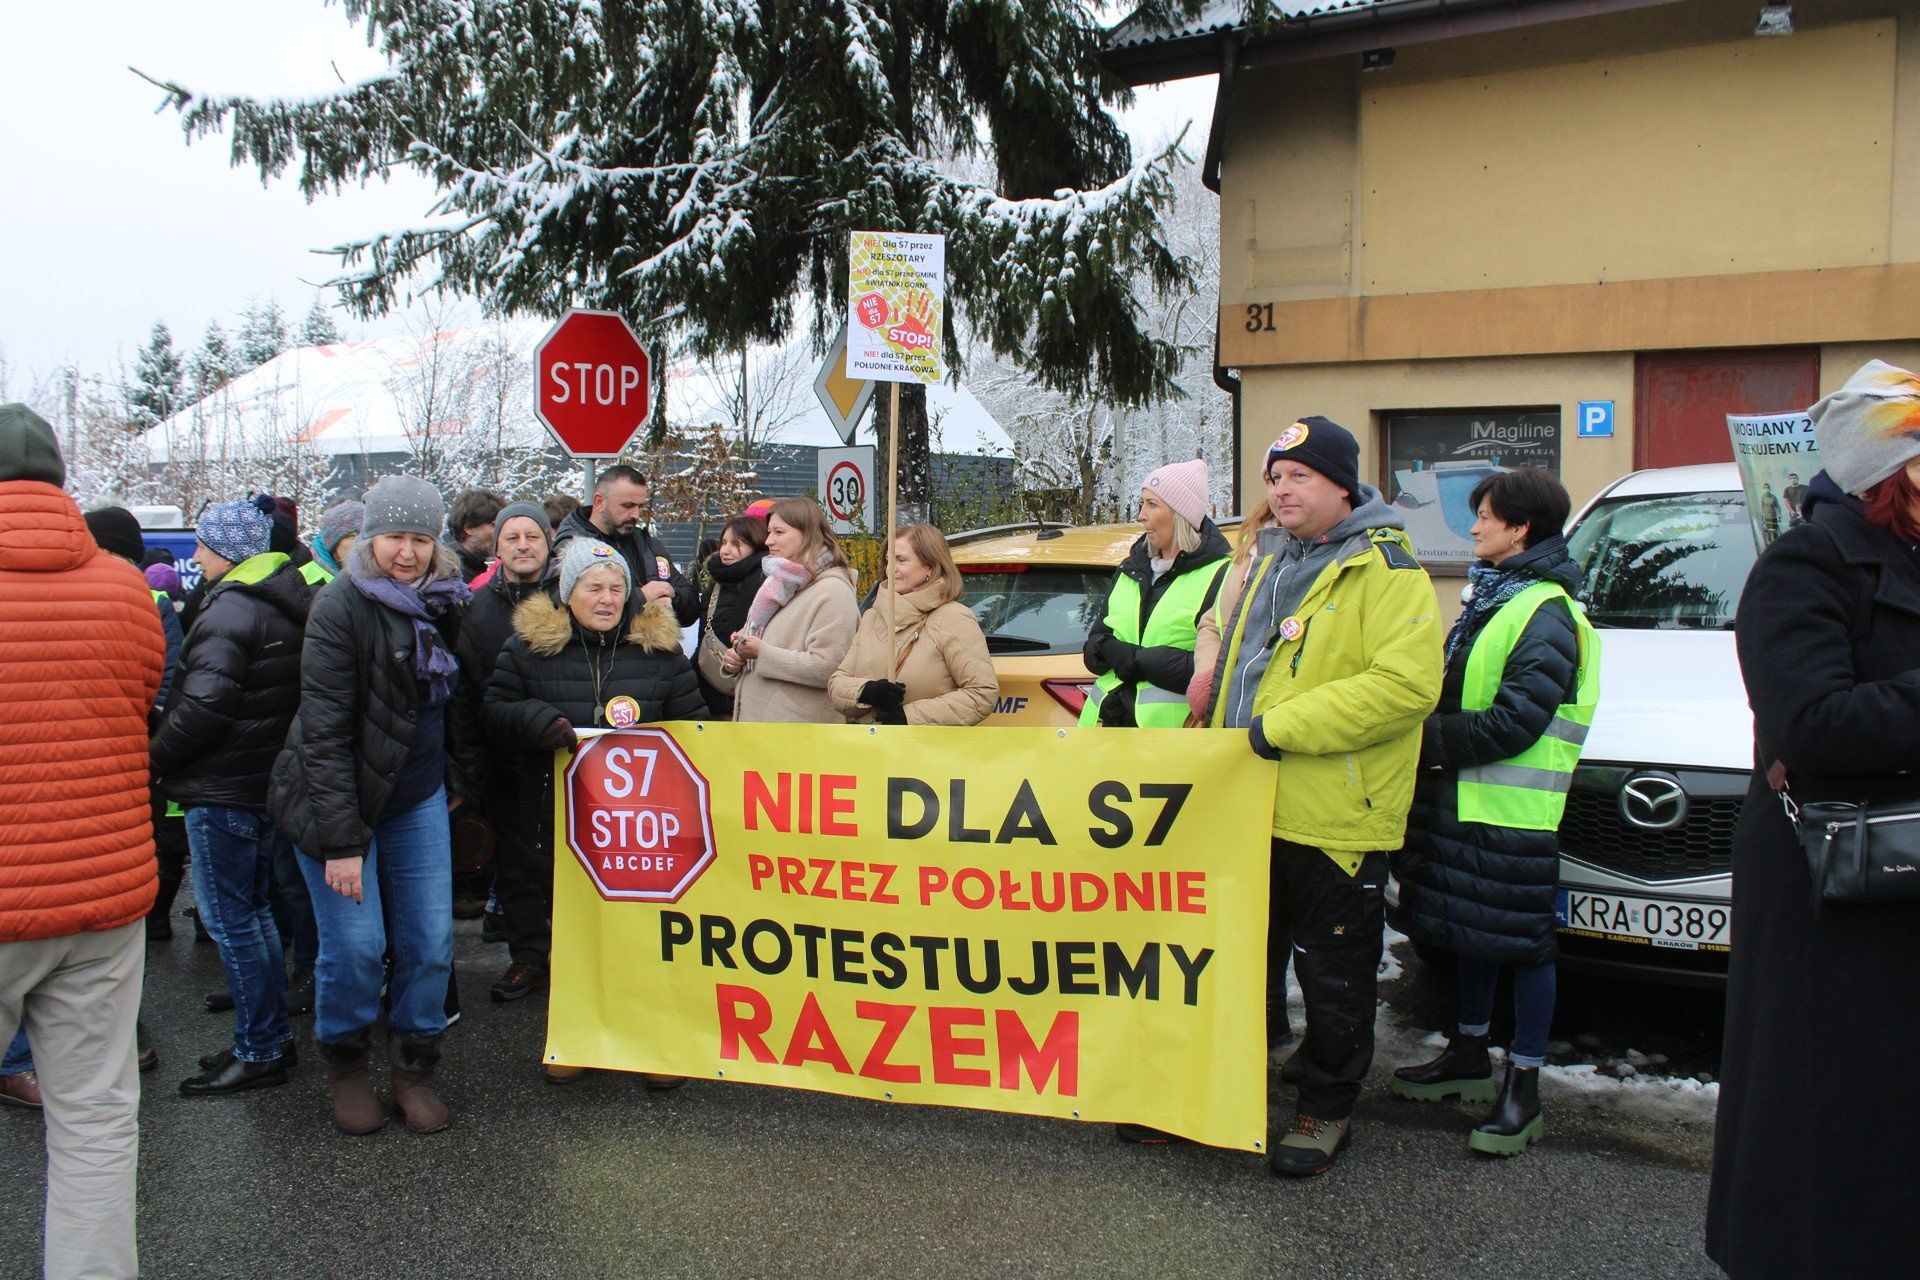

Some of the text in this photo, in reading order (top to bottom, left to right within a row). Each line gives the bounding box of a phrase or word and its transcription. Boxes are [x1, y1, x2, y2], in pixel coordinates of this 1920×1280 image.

[863, 239, 933, 250] NIE! dla S7 przez
[871, 252, 926, 263] RZESZOTARY
[895, 270, 914, 278] przez
[915, 271, 938, 280] GMINĘ
[862, 297, 879, 309] NIE
[869, 313, 881, 325] S7
[1246, 302, 1276, 333] 31
[889, 328, 932, 348] STOP!
[863, 350, 926, 362] NIE! dla S7 przez
[854, 361, 935, 374] POŁUDNIE KRAKOWA
[551, 361, 640, 406] STOP
[1586, 407, 1606, 432] P
[1733, 418, 1815, 436] MOGILANY 2
[1470, 421, 1555, 442] Magiline
[1514, 448, 1520, 456] Z
[1806, 439, 1818, 452] Z
[832, 476, 860, 506] 30
[620, 708, 633, 723] S7
[603, 746, 658, 798] S7
[743, 771, 1194, 849] NIE DLA S7
[591, 809, 680, 849] STOP
[602, 855, 674, 872] ABCDEF
[748, 853, 1207, 915] PRZEZ POŁUDNIE
[1570, 893, 1727, 940] KRA 0389
[1657, 940, 1694, 949] KRAKÓW
[659, 910, 1215, 1007] PROTESTUJEMY
[715, 983, 1080, 1097] RAZEM
